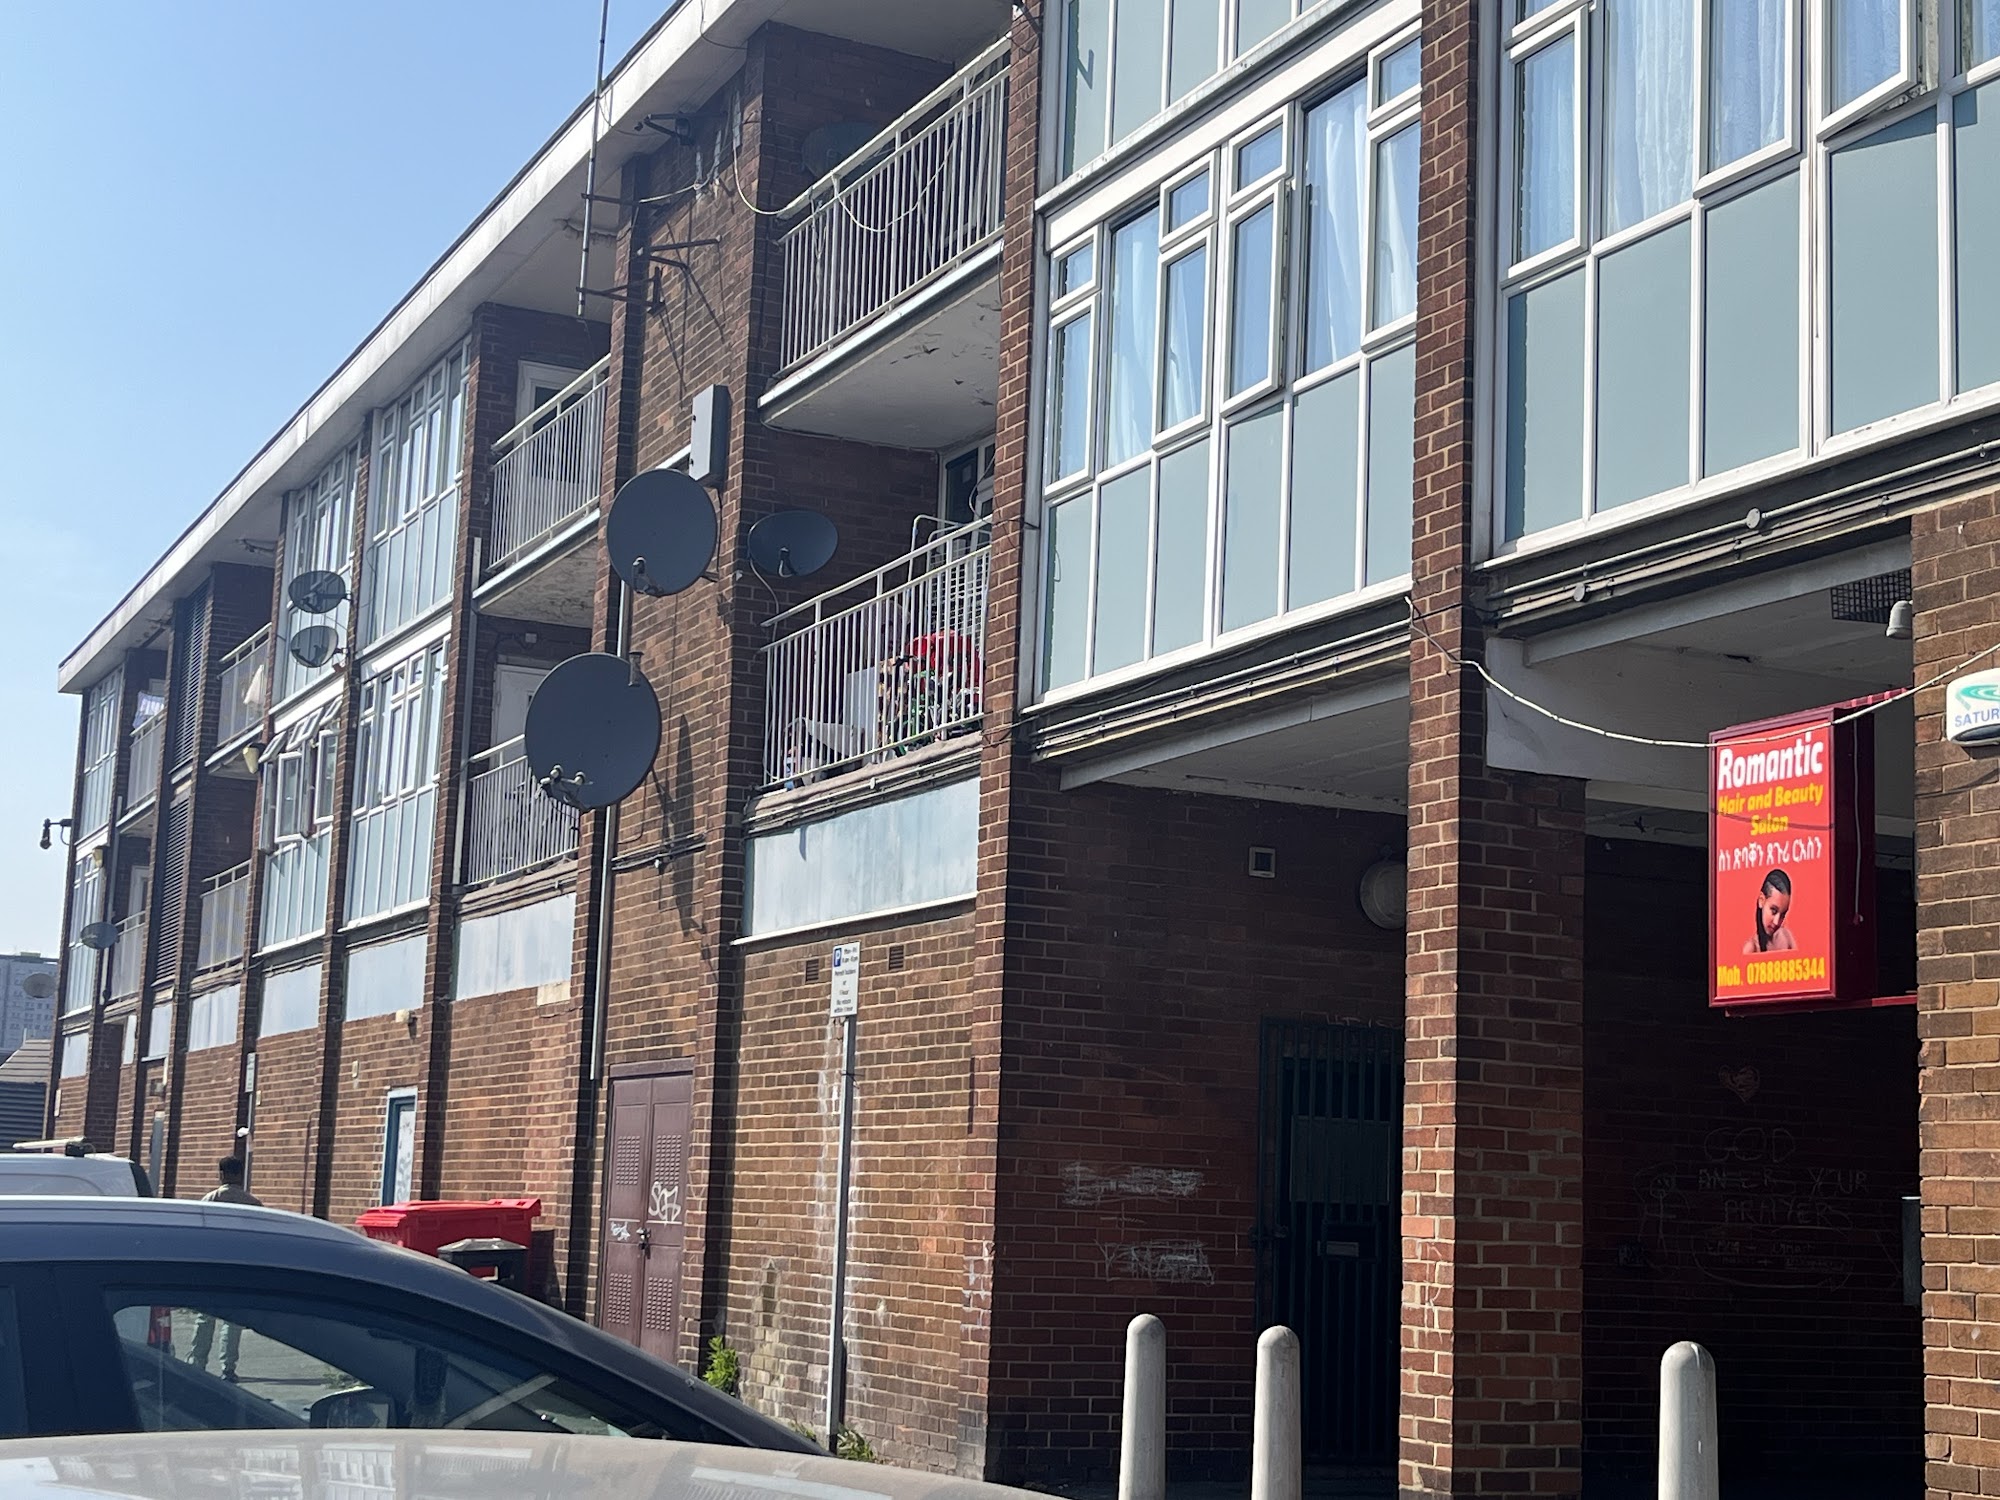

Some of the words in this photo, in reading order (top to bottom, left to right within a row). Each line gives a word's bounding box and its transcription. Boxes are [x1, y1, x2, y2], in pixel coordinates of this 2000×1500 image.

[1718, 732, 1824, 790] Romantic
[1718, 792, 1746, 814] Hair
[1747, 787, 1772, 811] and
[1774, 782, 1824, 807] Beauty
[1750, 813, 1788, 836] Salon
[1717, 965, 1743, 987] Mob.
[1747, 957, 1825, 985] 07888885344
